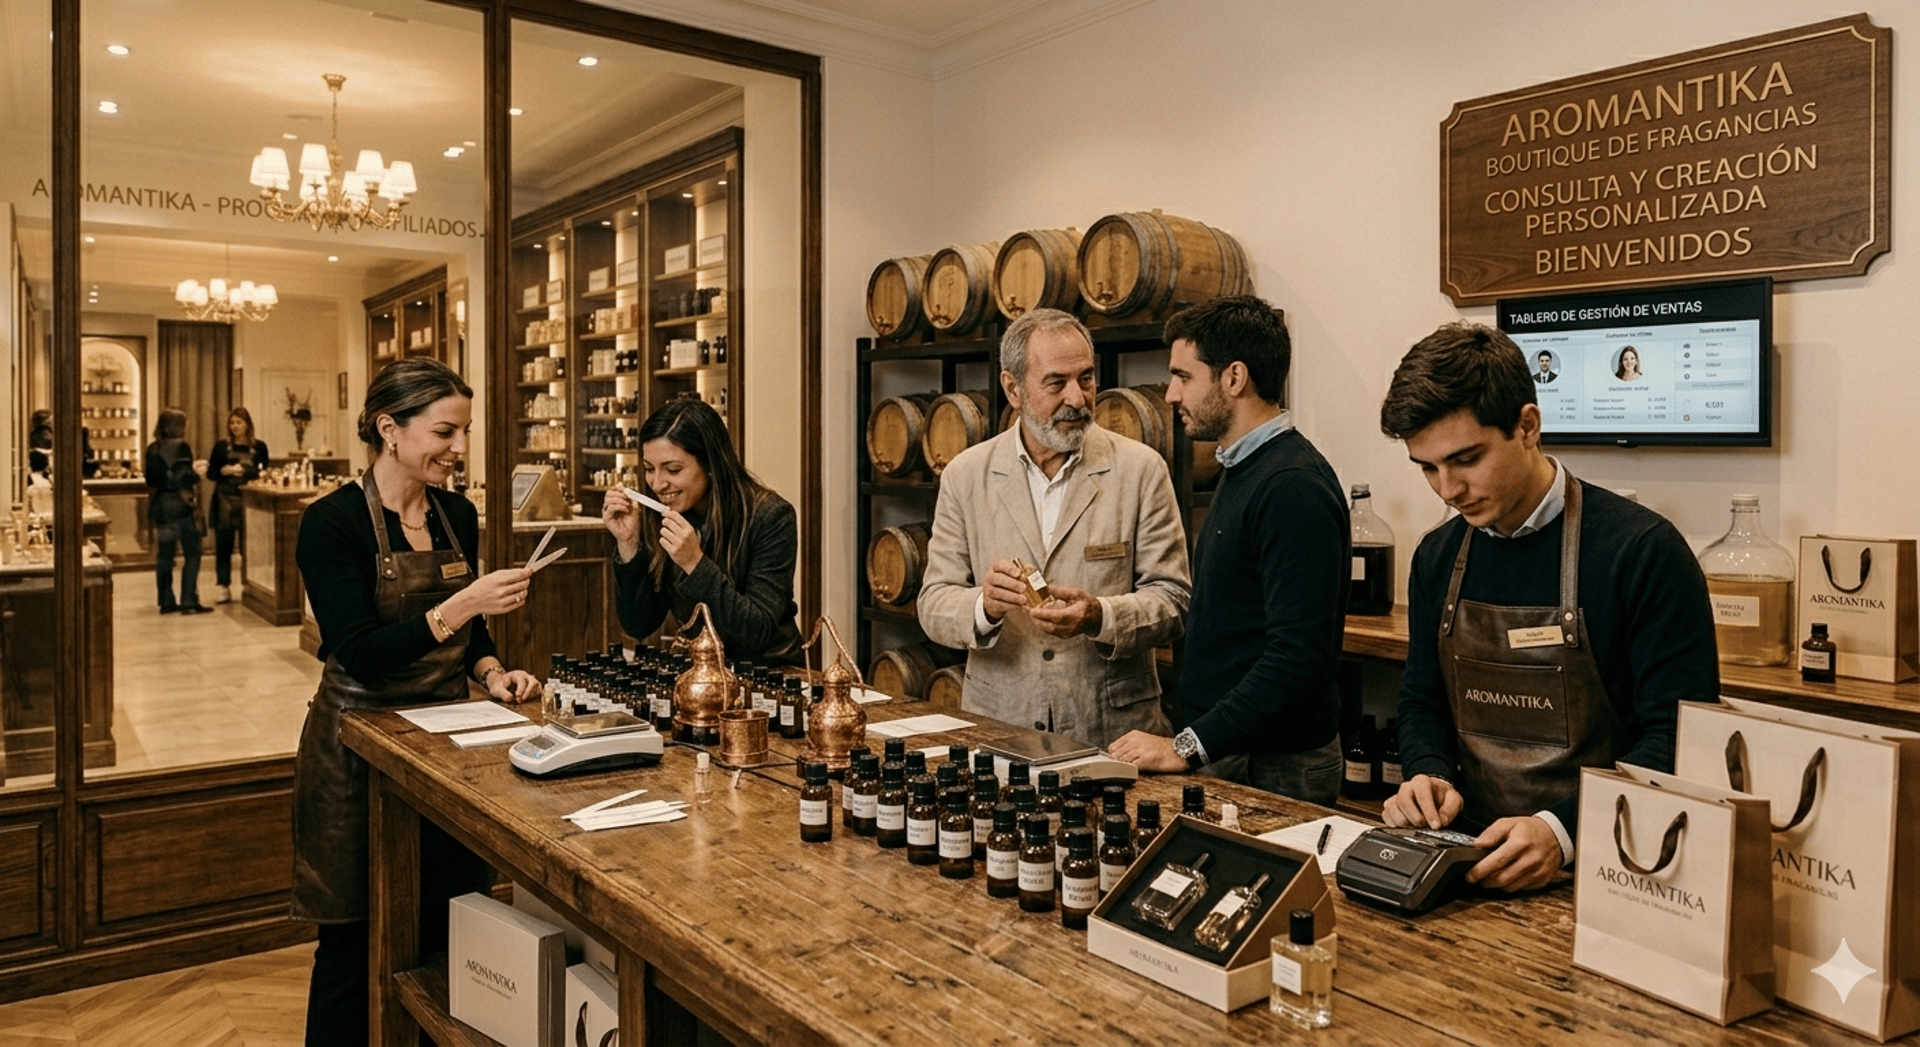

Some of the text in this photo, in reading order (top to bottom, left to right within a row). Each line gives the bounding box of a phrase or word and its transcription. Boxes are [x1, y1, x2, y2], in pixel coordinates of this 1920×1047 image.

[1501, 61, 1794, 147] AROMANTIKA
[1486, 102, 1818, 177] BOUTIQUE DE FRAGANCIAS
[31, 178, 197, 213] AMANTIKA
[1484, 143, 1818, 214] CONSULTA Y CREACIÓN
[1526, 185, 1767, 238] PERSONALIZADA
[1536, 227, 1752, 275] BIENVENIDOS
[1510, 300, 1703, 325] TABLERO DE GESTIÓN DE VENTAS
[1465, 689, 1554, 711] AROMANTIKA
[1596, 865, 1706, 914] AROMANTIKA
[1771, 847, 1857, 891] ANTIKA
